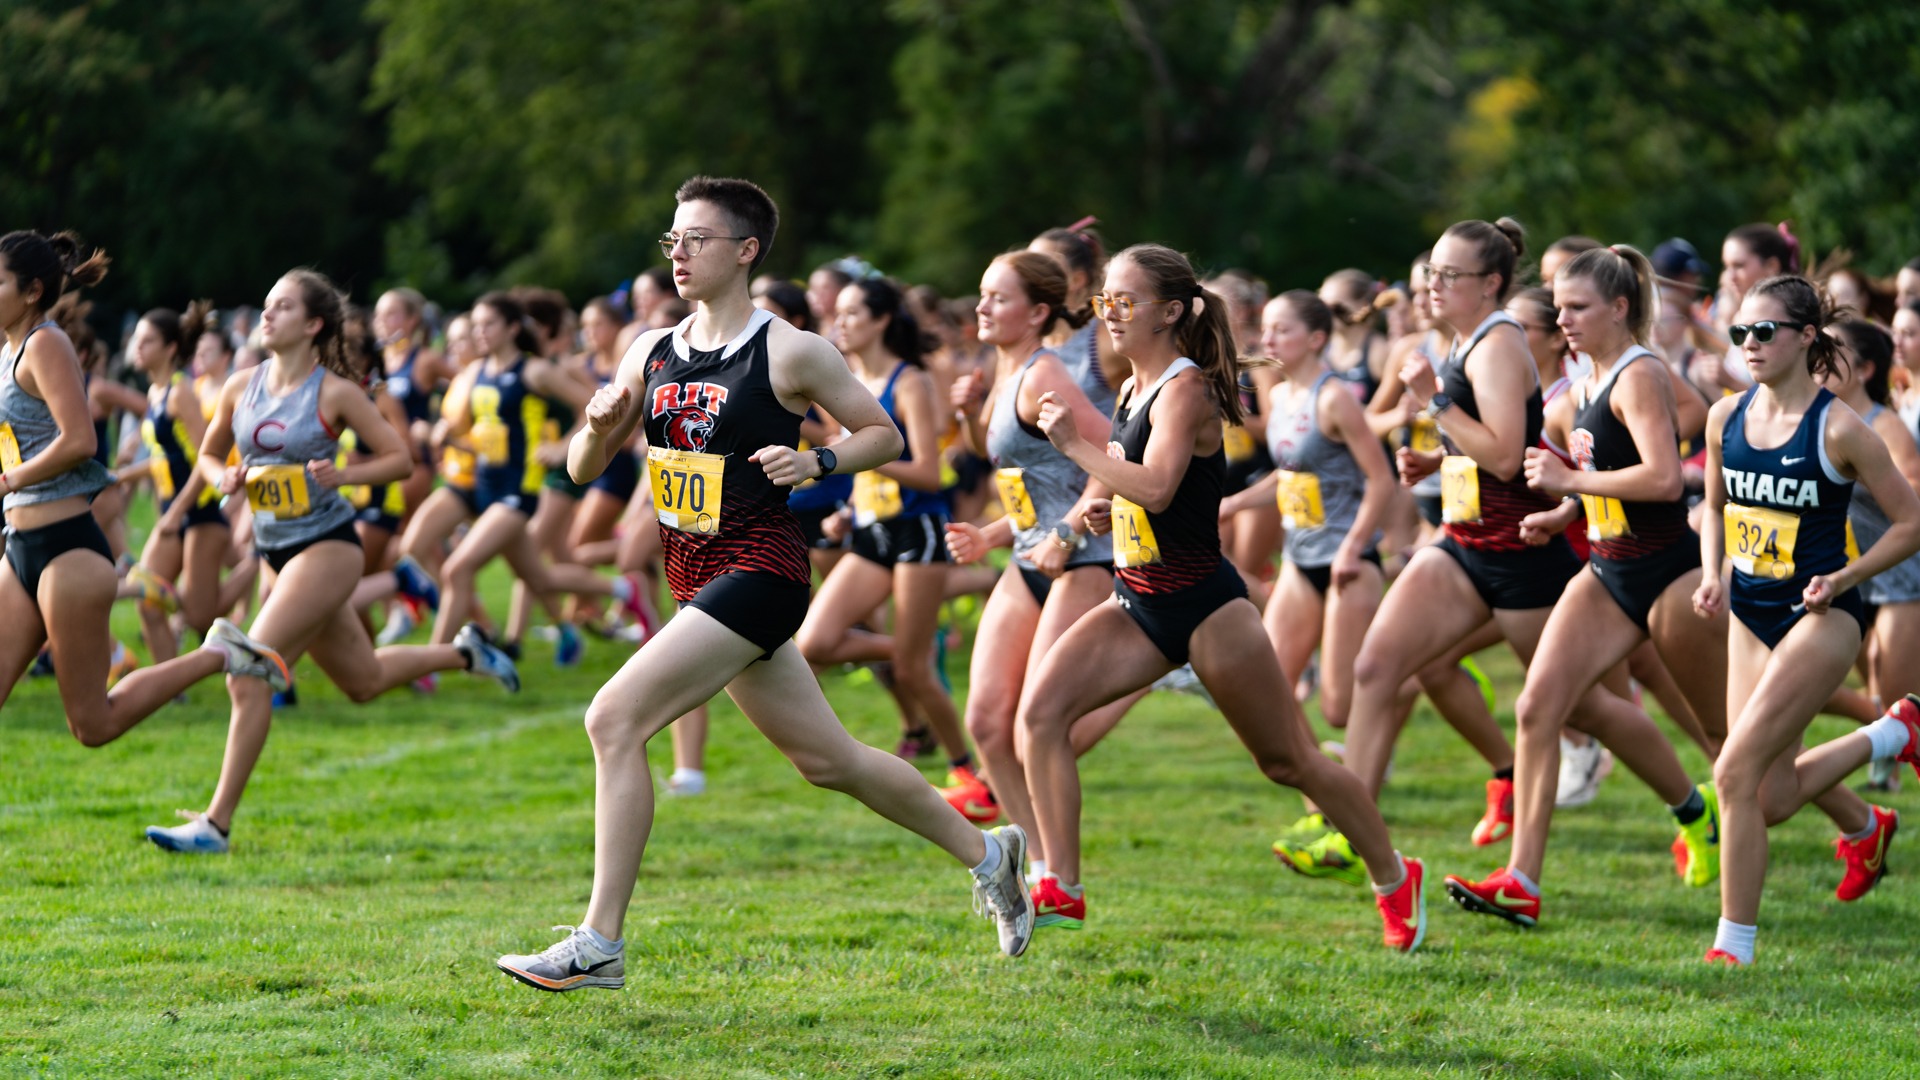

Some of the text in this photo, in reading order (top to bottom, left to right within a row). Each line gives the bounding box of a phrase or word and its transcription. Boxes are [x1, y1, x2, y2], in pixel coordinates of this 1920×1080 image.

[652, 382, 729, 419] RIT
[255, 477, 294, 507] 291
[660, 469, 705, 513] 370
[1722, 465, 1820, 508] THACA
[1737, 520, 1779, 561] 324
